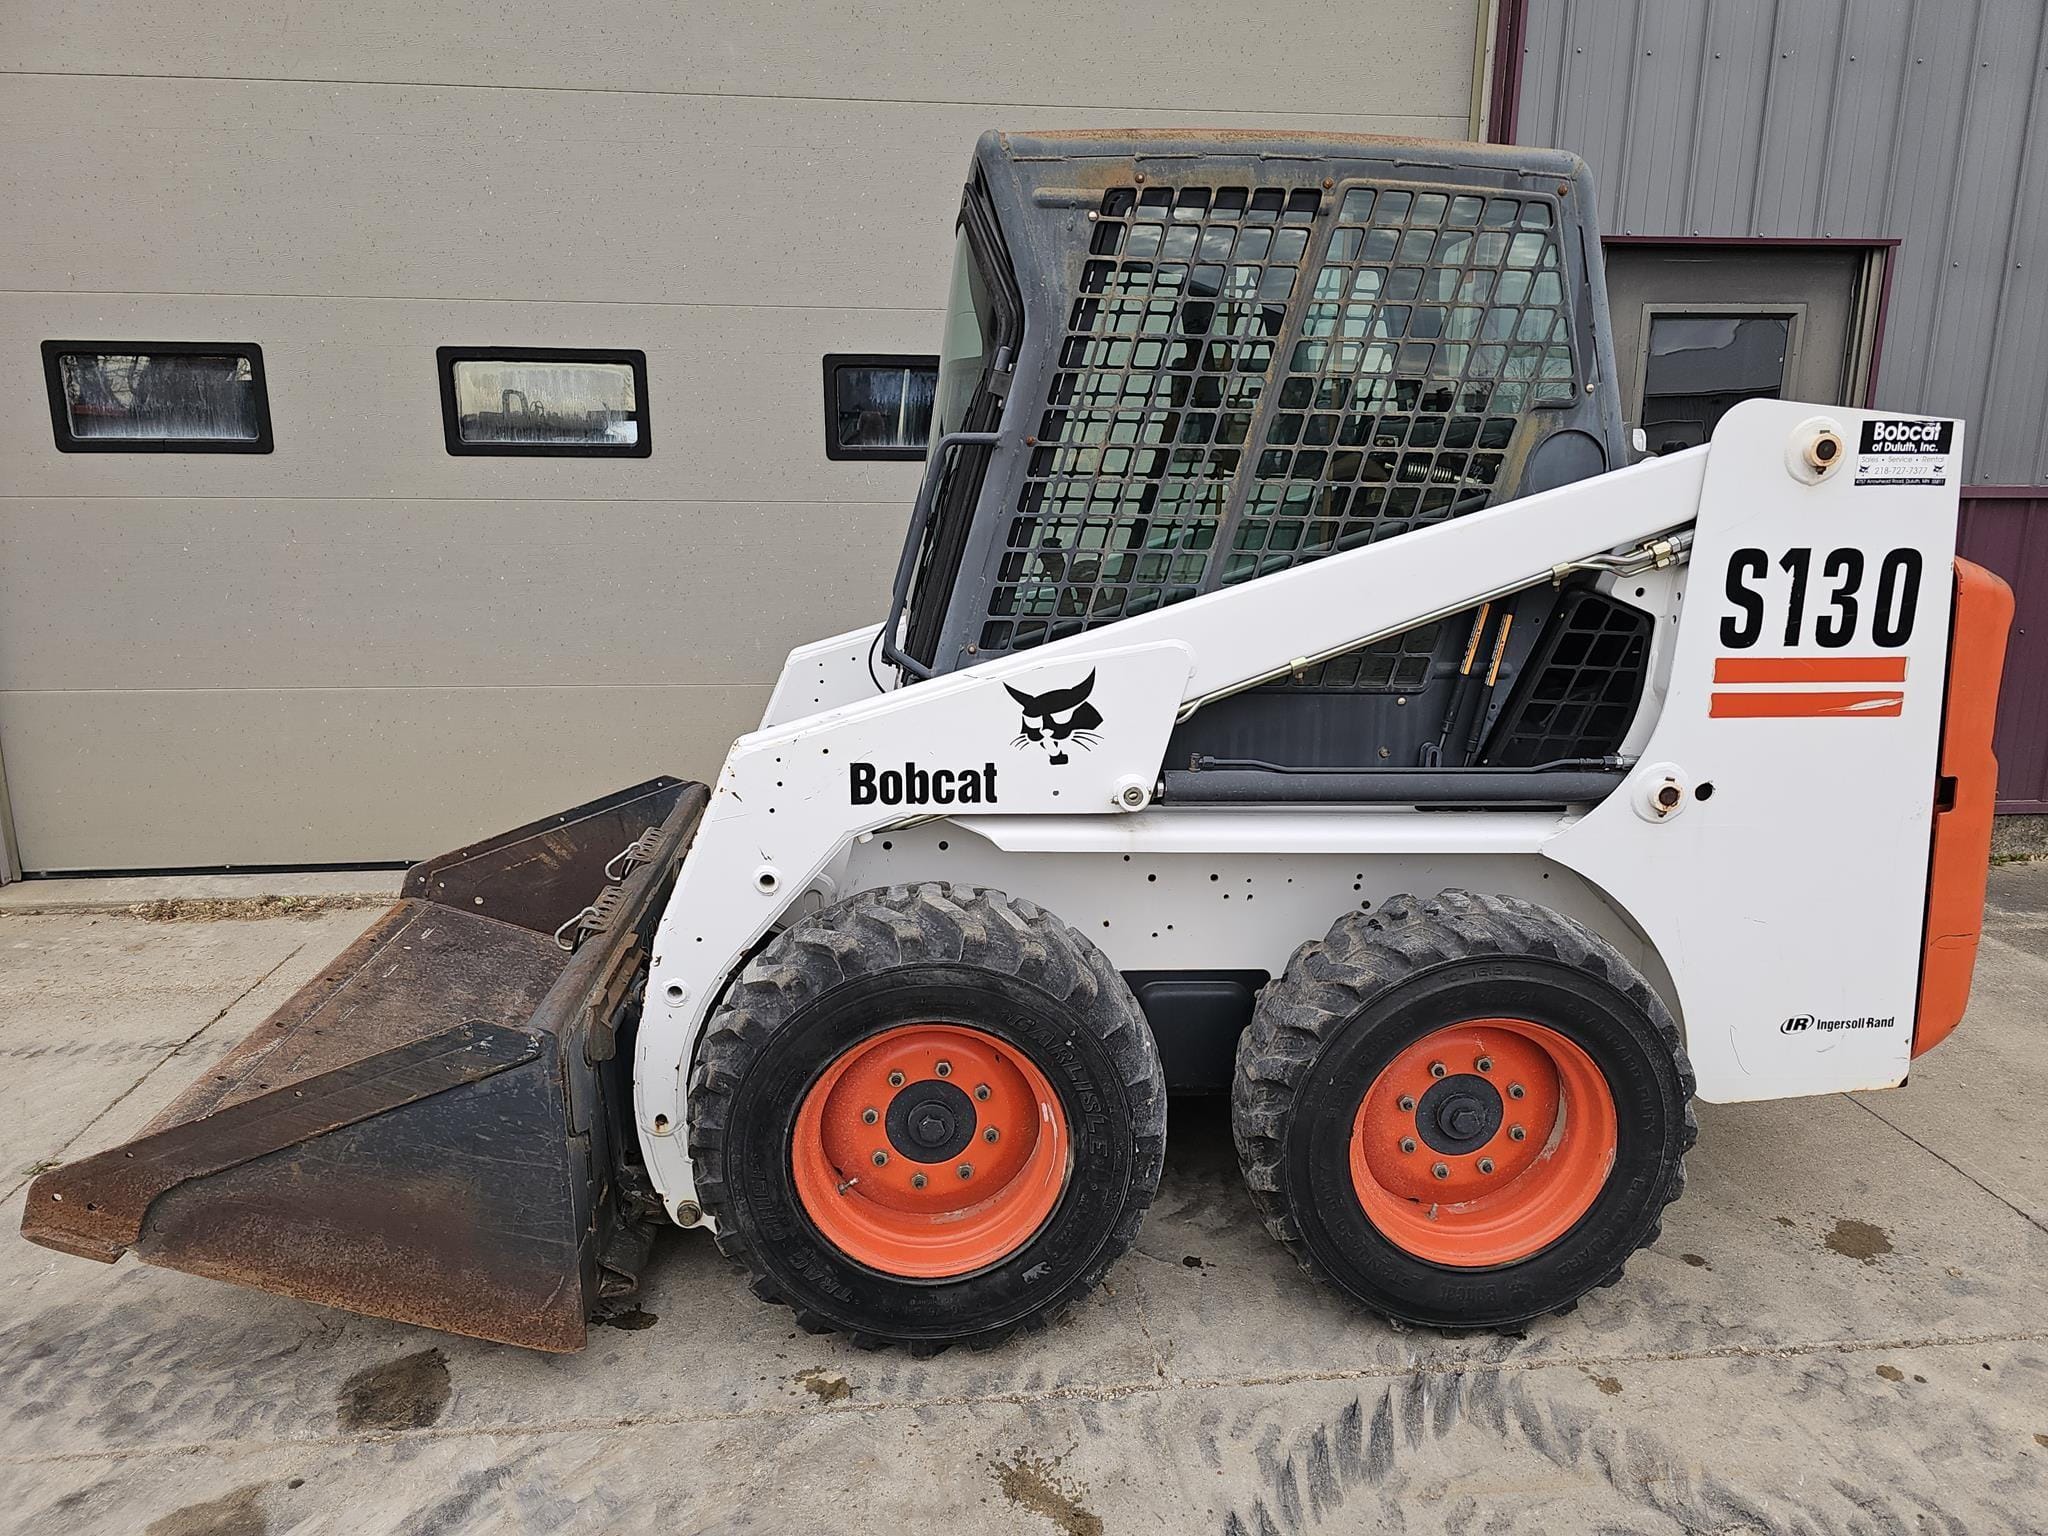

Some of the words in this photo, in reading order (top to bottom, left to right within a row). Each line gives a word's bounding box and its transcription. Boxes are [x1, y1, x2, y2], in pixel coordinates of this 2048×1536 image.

[1873, 421, 1941, 441] Bobcat
[1872, 441, 1882, 452] of
[1884, 442, 1917, 453] Duluth,
[1920, 442, 1938, 452] Inc.
[1874, 466, 1929, 475] 218-727-7377
[1719, 547, 1923, 649] S130
[850, 762, 998, 805] Bobcat
[1816, 1016, 1895, 1032] Ingersoll-Rand
[1007, 1011, 1108, 1157] CARLISLE
